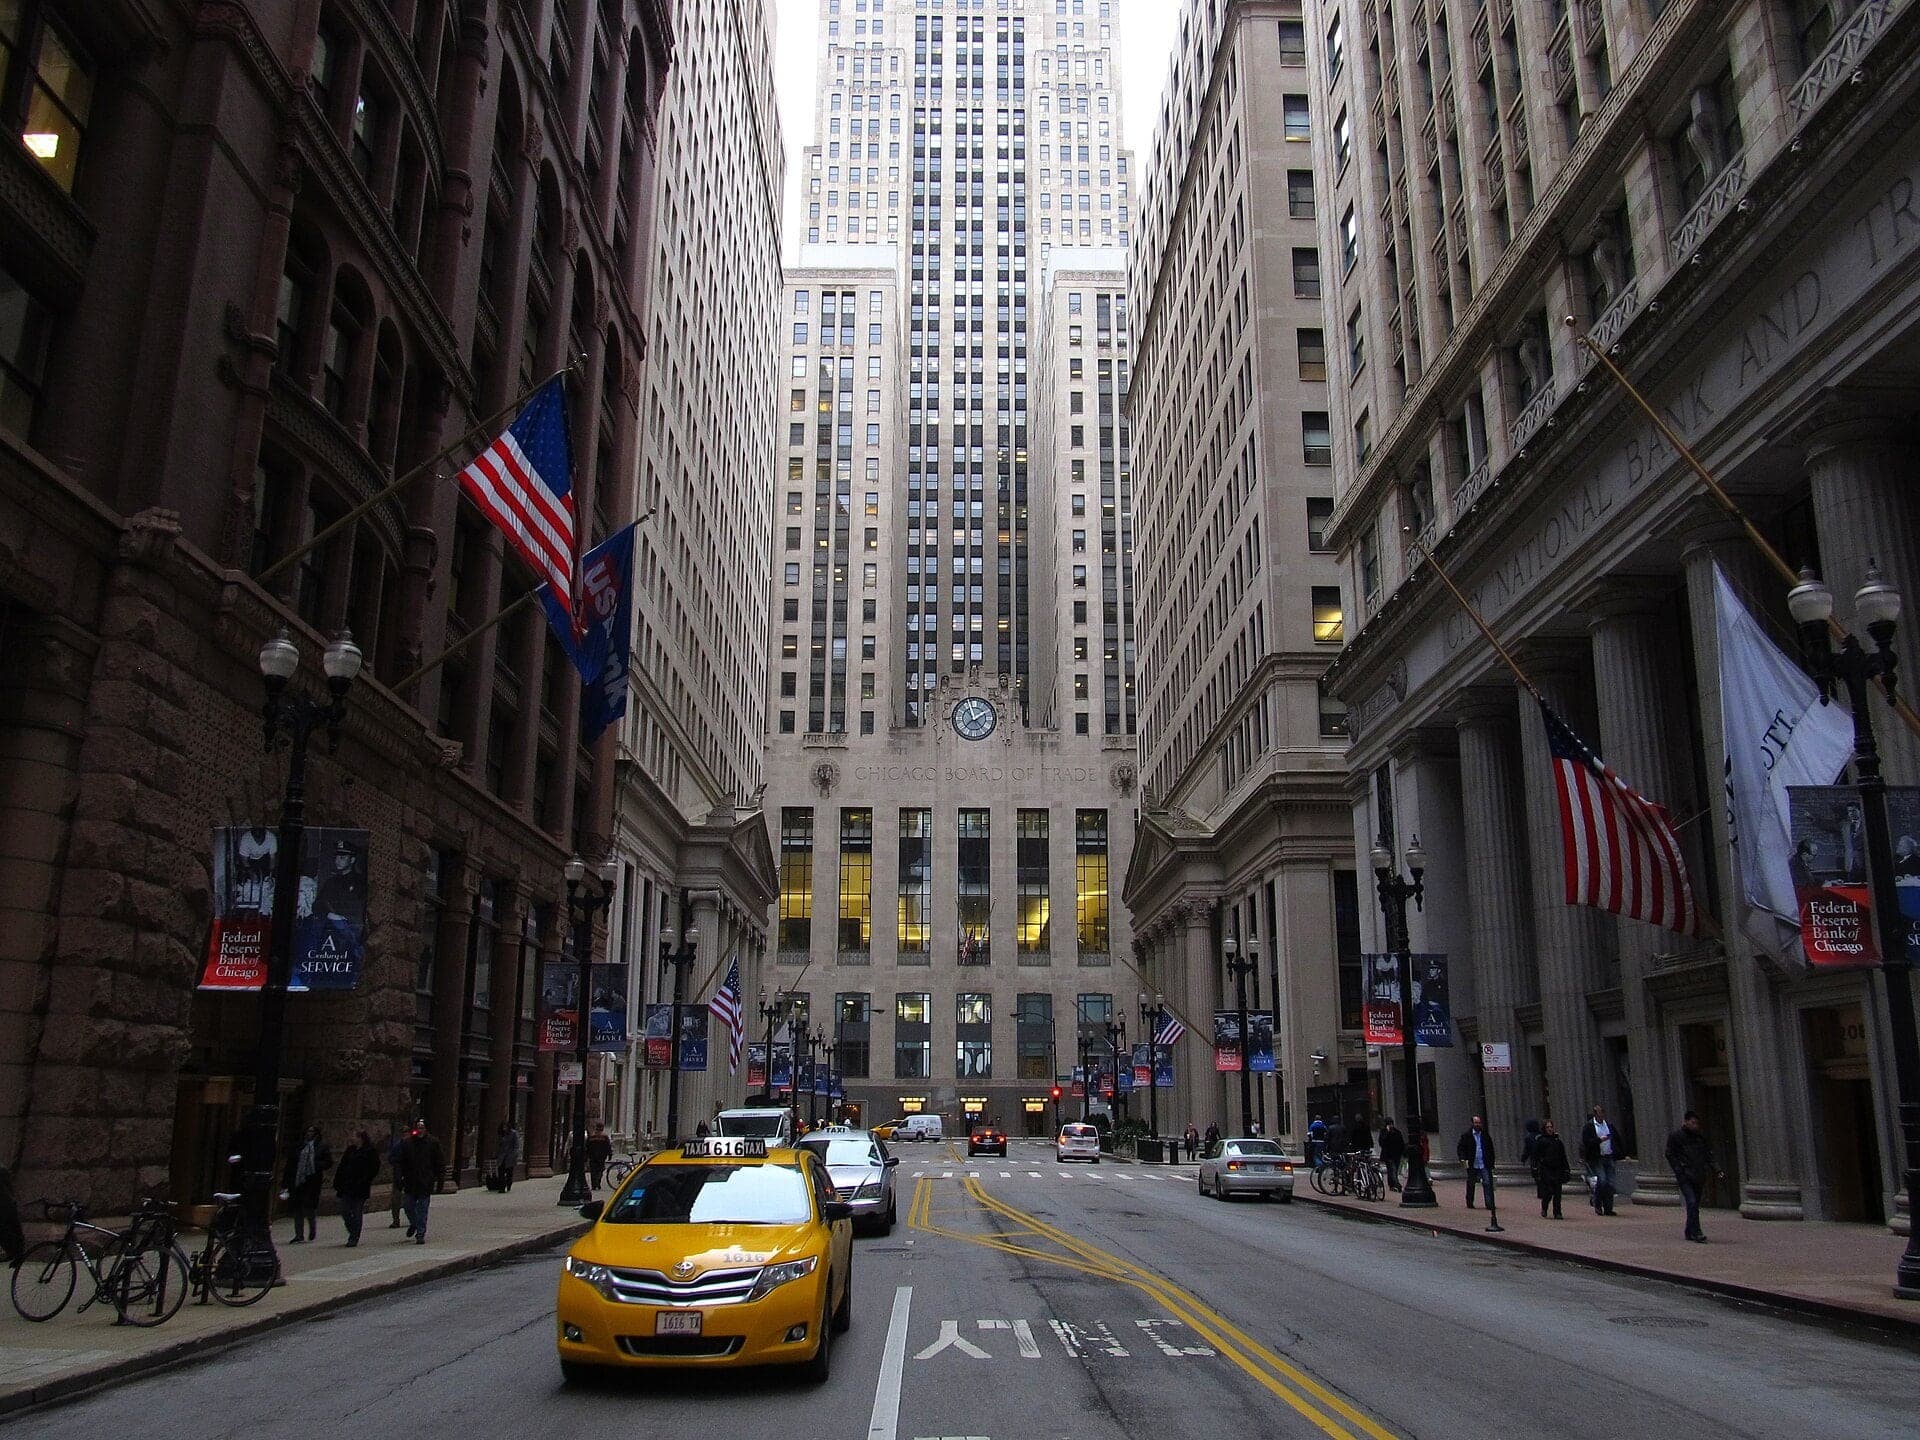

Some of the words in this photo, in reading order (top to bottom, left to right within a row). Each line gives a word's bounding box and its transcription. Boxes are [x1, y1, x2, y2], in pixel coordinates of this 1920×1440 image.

[1495, 485, 1613, 605] NATIONAL
[1626, 378, 1715, 489] BANK
[1737, 269, 1822, 389] AND
[854, 765, 937, 782] CHICAGO
[945, 765, 1004, 782] BOARD
[1011, 766, 1034, 782] OF
[1042, 765, 1098, 783] TRADE
[1809, 900, 1858, 914] Federal
[1811, 914, 1860, 926] Reserve
[221, 931, 261, 943] Federal
[1813, 926, 1846, 939] Bank
[1848, 927, 1861, 941] of
[220, 943, 261, 954] Reserve
[321, 935, 336, 951] A
[1814, 939, 1864, 954] Chicago
[218, 954, 248, 965] Bank
[248, 955, 260, 967] of
[300, 961, 353, 973] SERVICE
[215, 966, 259, 979] Chicago
[1368, 1011, 1394, 1019] Federal
[1369, 1030, 1396, 1038] Chicago
[685, 1142, 705, 1155] TAXI
[704, 1141, 744, 1156] 1616
[744, 1142, 764, 1155] TAXI
[723, 1253, 765, 1263] 1616
[663, 1316, 684, 1329] 1616
